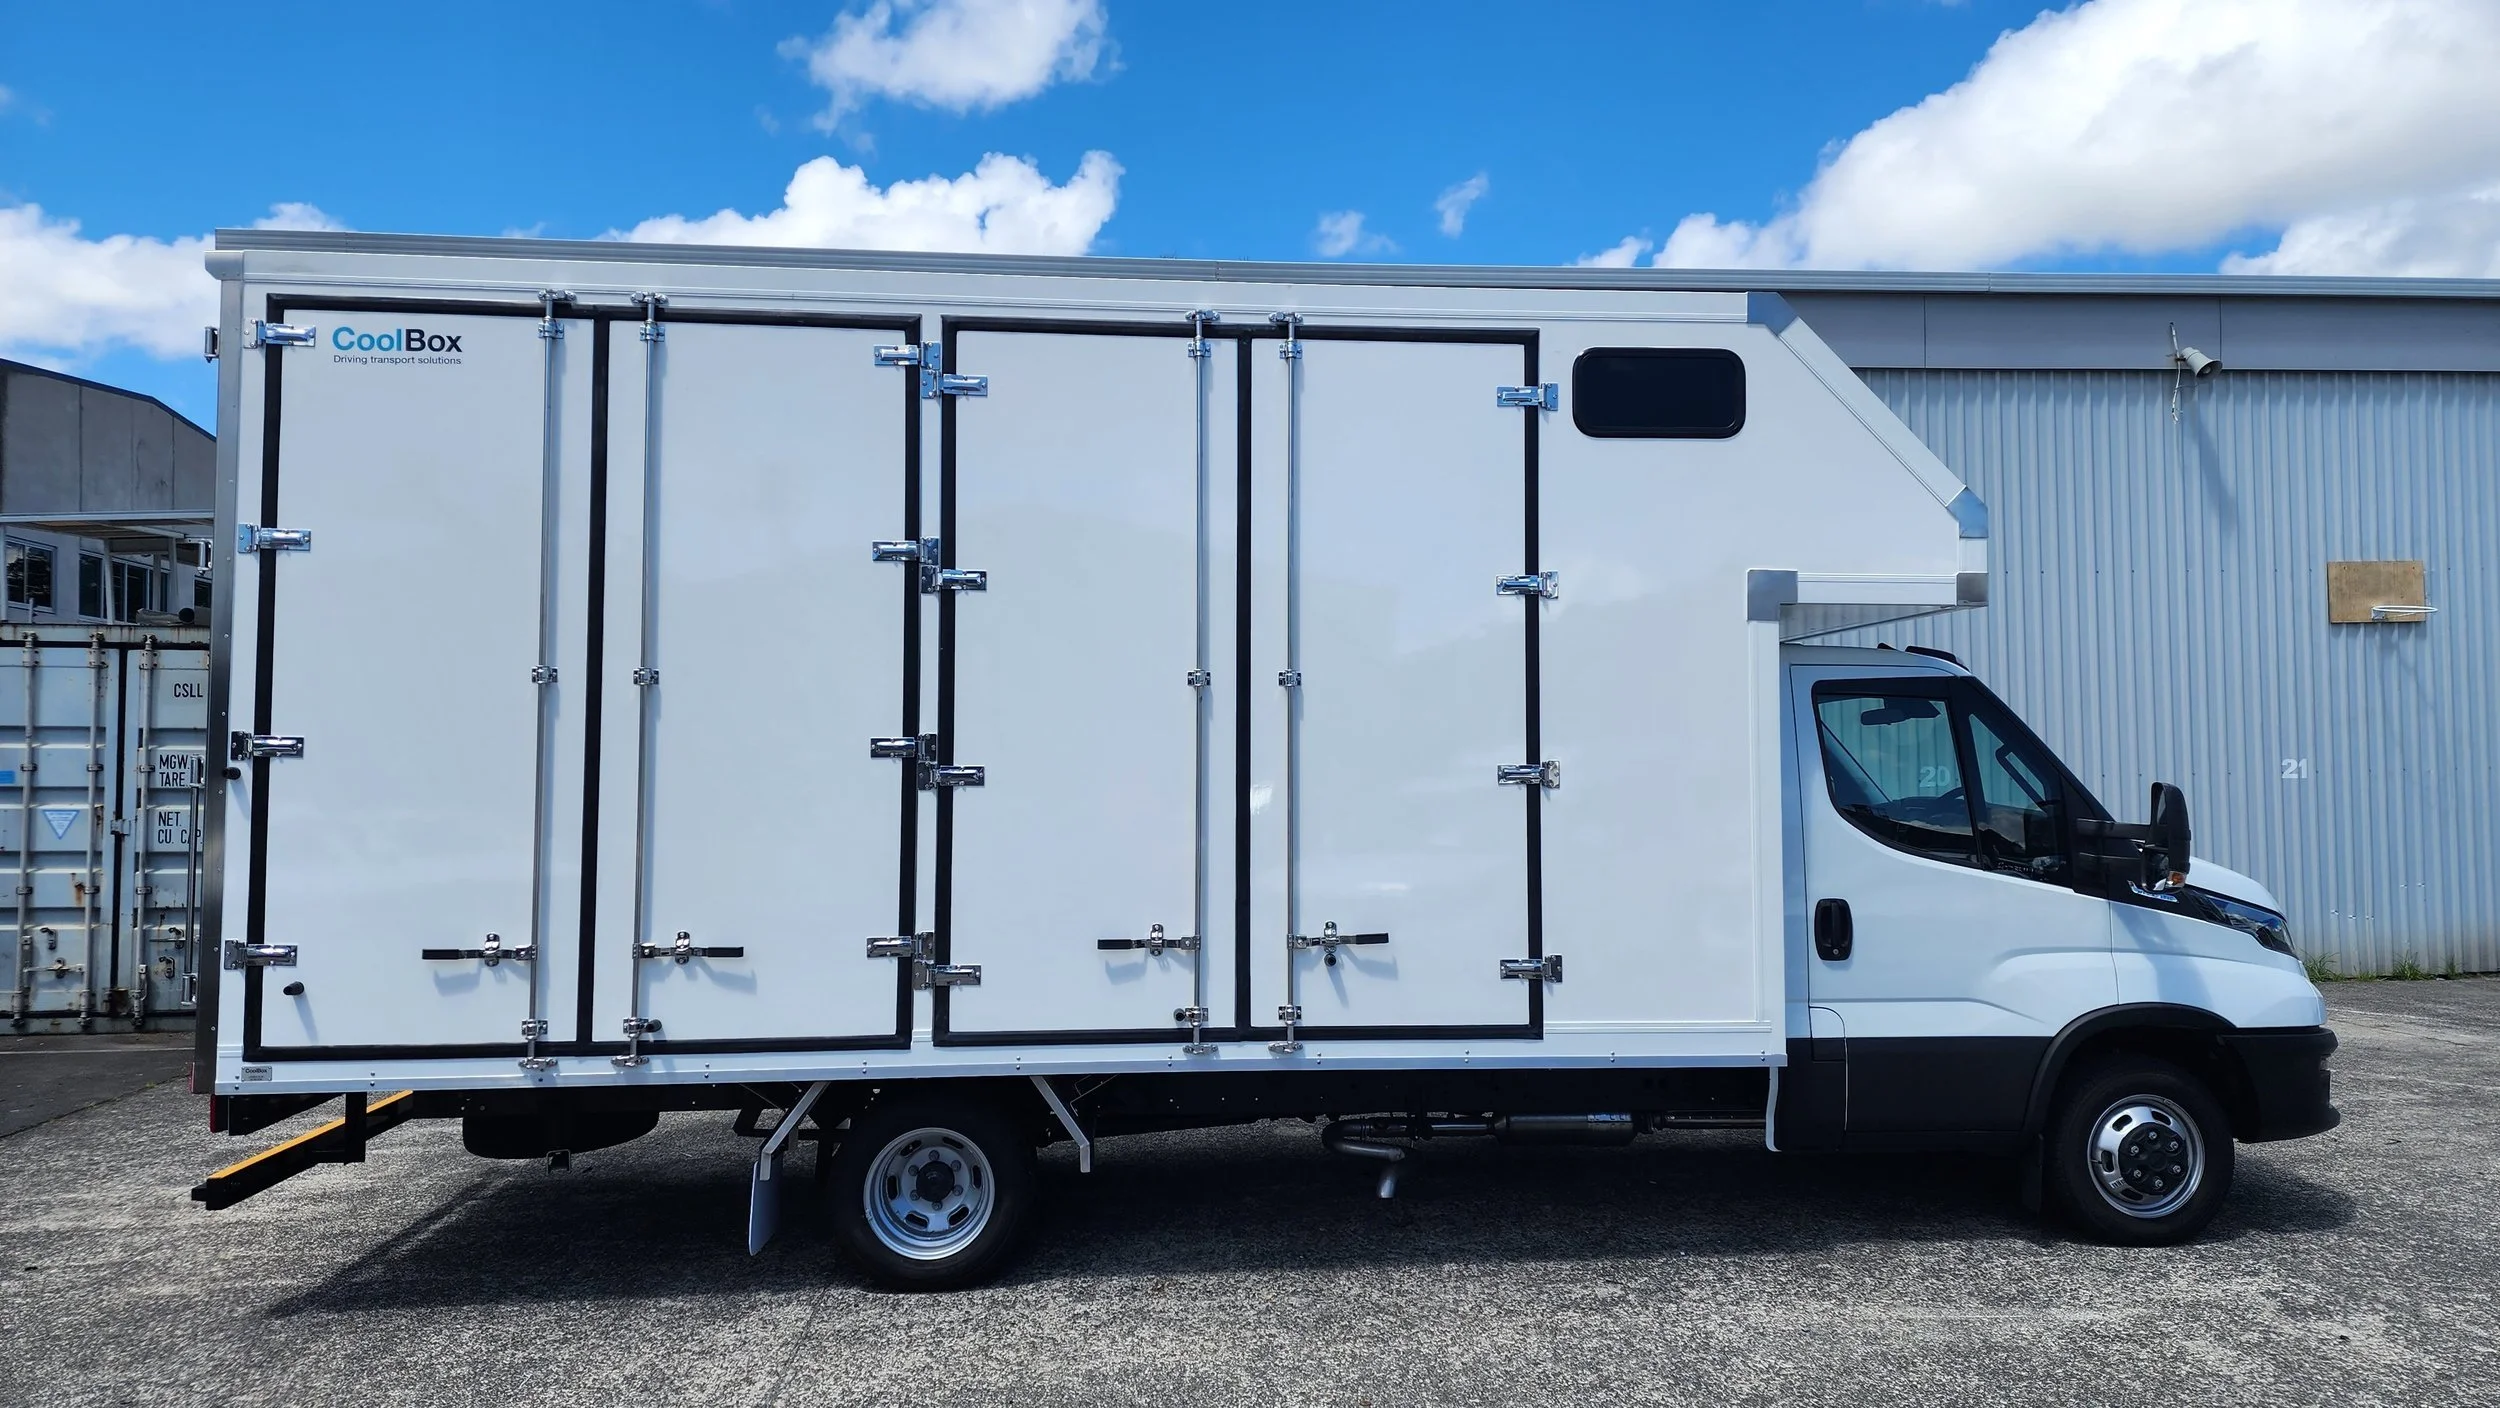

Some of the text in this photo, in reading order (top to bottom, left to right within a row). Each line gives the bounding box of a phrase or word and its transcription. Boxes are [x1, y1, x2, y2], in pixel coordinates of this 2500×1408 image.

[332, 326, 462, 353] CoolBox
[333, 355, 462, 365] Driving transport solutions
[173, 683, 203, 698] CSLL
[160, 754, 190, 770] MGW.
[2281, 758, 2308, 779] 21
[1920, 765, 1950, 788] 20
[158, 811, 182, 827] NET.
[157, 829, 174, 844] CU.
